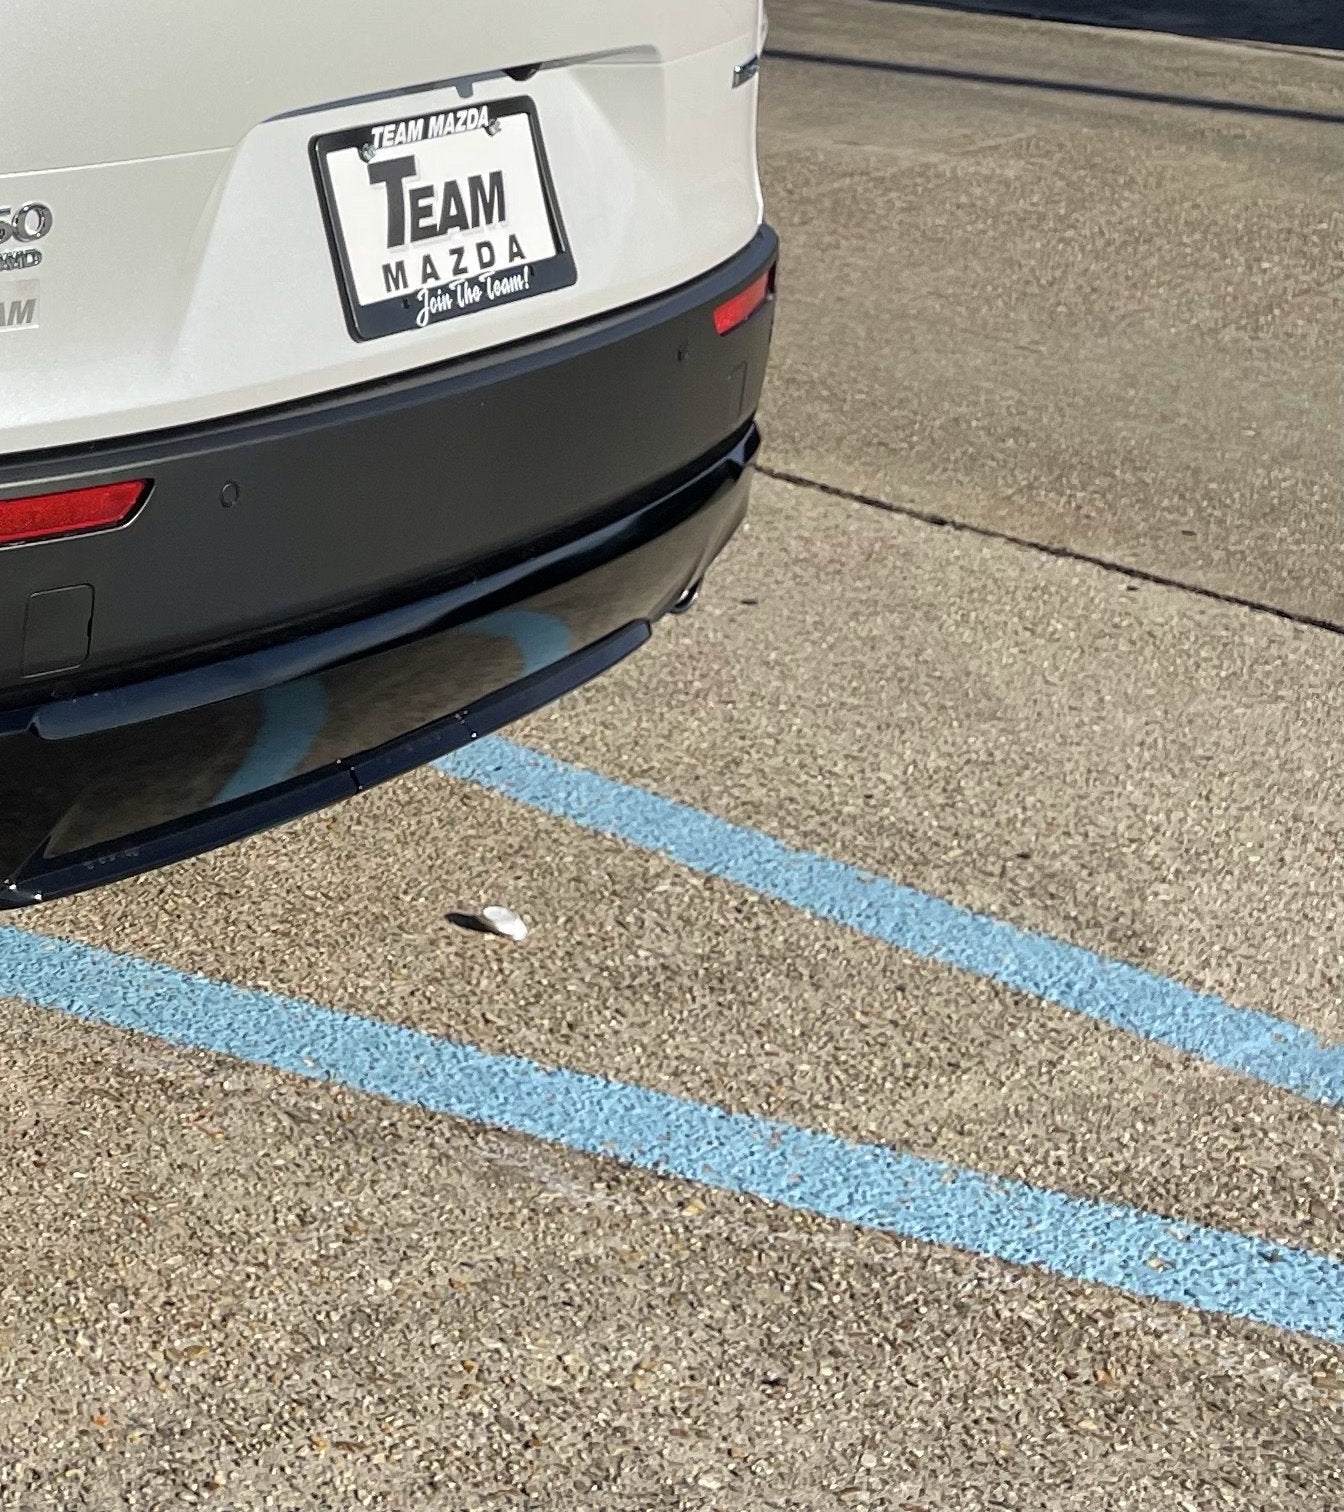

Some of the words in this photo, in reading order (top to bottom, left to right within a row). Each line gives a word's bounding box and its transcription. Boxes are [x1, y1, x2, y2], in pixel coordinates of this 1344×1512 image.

[371, 118, 424, 148] TEAM
[428, 105, 489, 138] MAZDA
[367, 155, 506, 249] TEAM
[382, 233, 526, 293] MAZDA
[416, 288, 453, 327] Join
[448, 276, 482, 308] The
[478, 265, 530, 301] Team!
